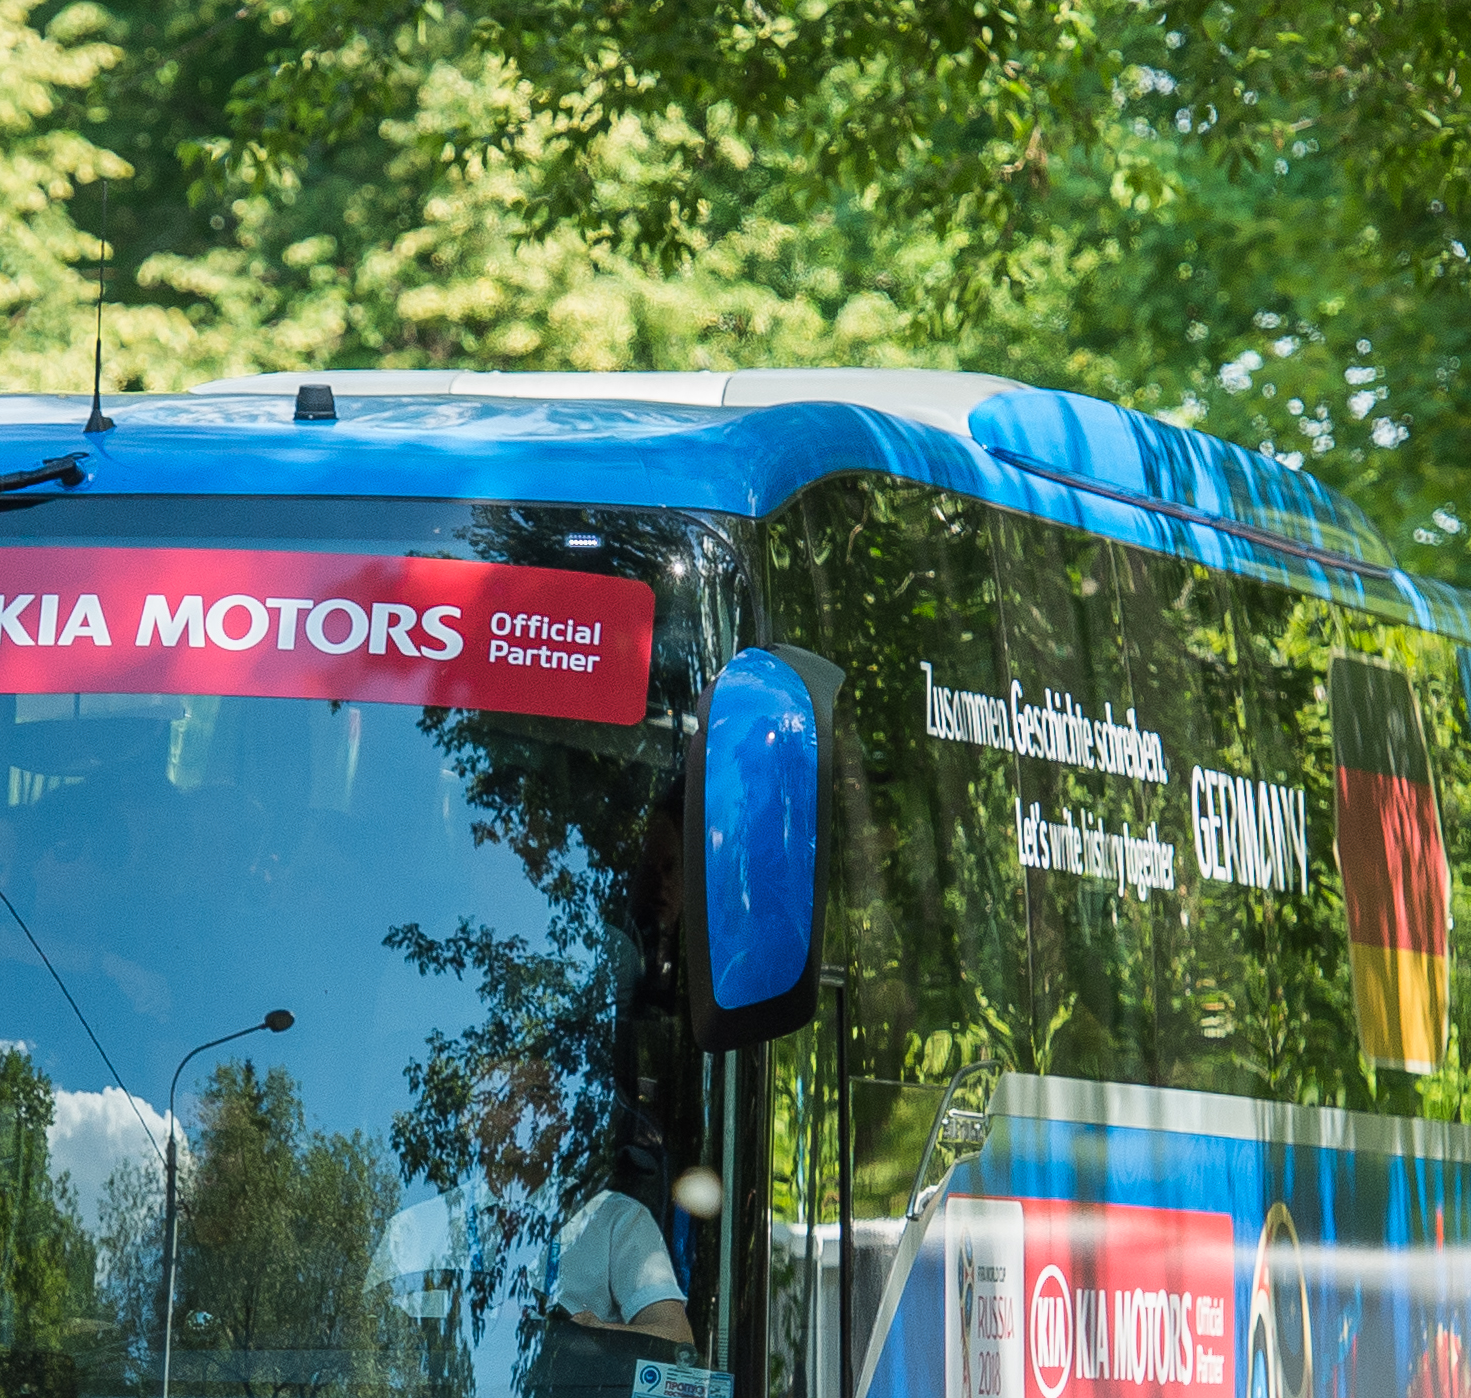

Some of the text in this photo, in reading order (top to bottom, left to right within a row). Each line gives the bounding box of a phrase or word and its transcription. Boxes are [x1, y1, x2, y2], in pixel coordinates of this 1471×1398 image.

[135, 594, 464, 661] MOTORS
[489, 640, 601, 673] Partner
[490, 611, 602, 645] Official
[1011, 679, 1096, 770] Geschichte
[1049, 807, 1083, 875] write
[1191, 765, 1308, 896] GERMANY
[978, 1295, 1015, 1340] RUSSIA
[1076, 1287, 1194, 1386] KIA MOTORS
[979, 1351, 1002, 1396] 2018
